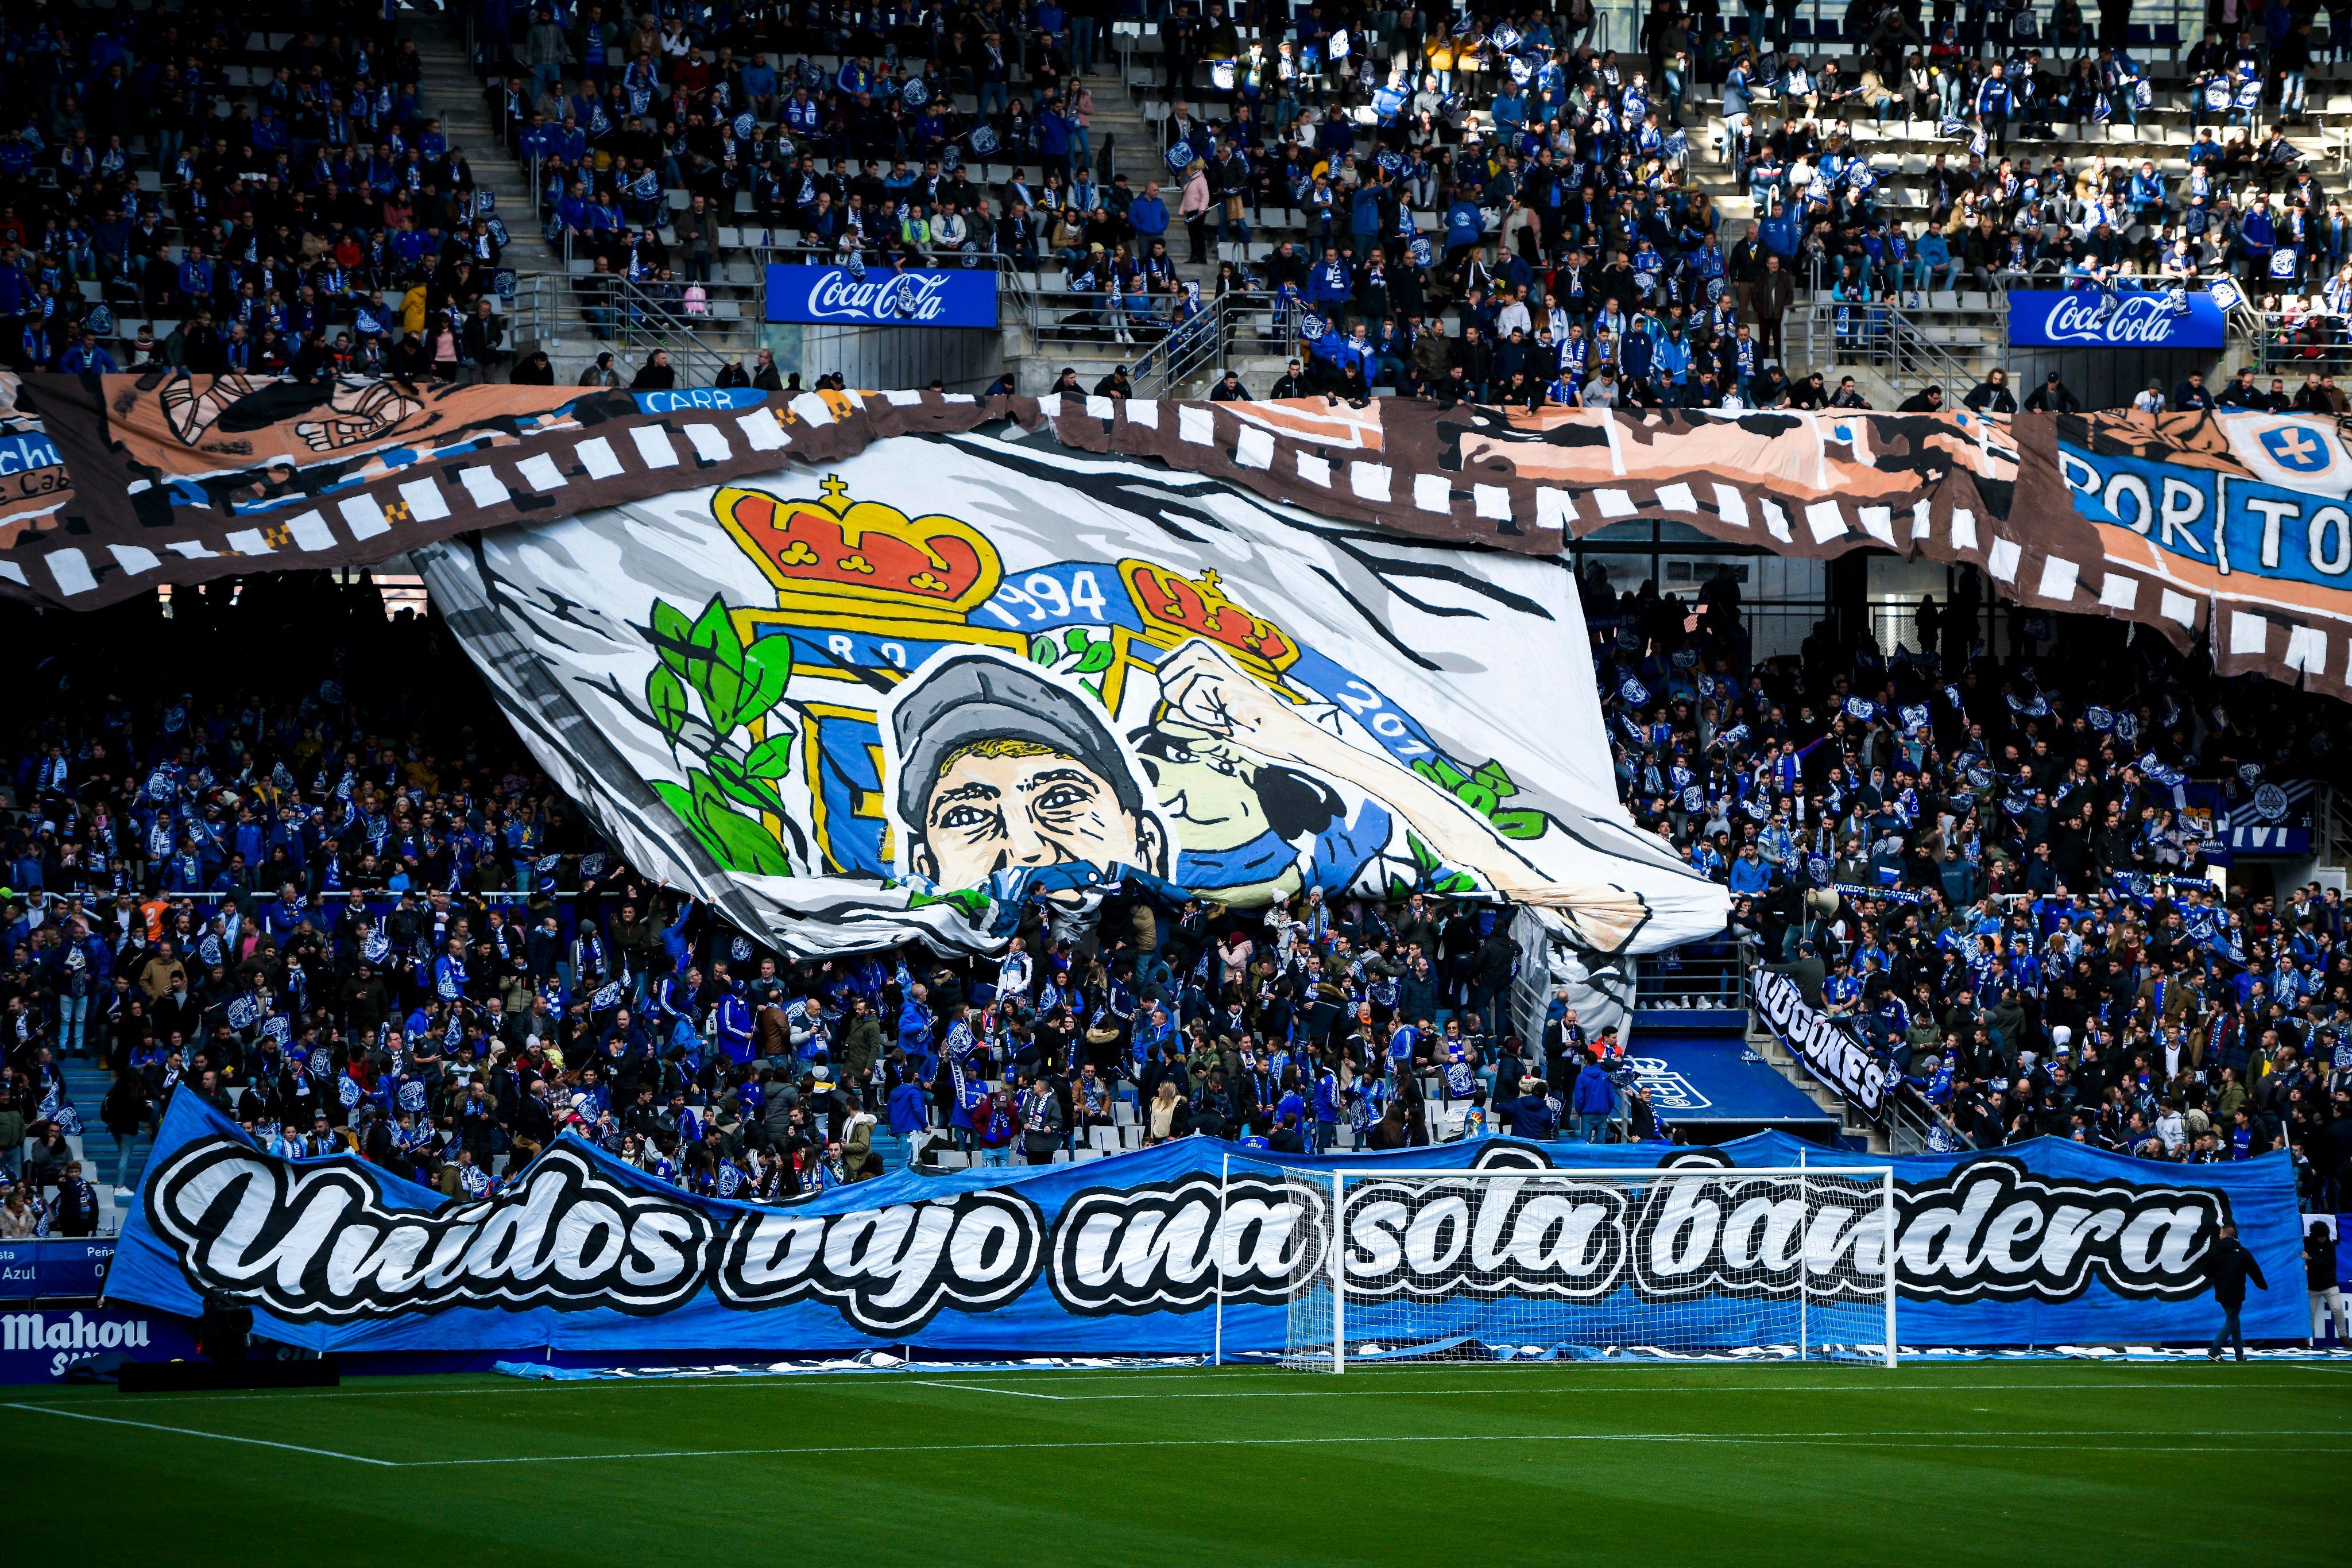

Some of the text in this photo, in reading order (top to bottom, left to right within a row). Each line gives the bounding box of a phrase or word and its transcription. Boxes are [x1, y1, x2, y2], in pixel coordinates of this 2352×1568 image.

[808, 271, 951, 320] Coca-Cla
[2045, 295, 2173, 342] CocaCola
[2059, 450, 2351, 575] POR TO
[983, 571, 1107, 628] 1994
[828, 634, 855, 664] R
[1833, 883, 1920, 903] OVIEDO CAPITAL
[2171, 876, 2207, 886] CAPITAL
[146, 908, 156, 927] 2
[1758, 969, 1885, 1109] LUGONES
[175, 1157, 693, 1296] Unidos
[1075, 1201, 1307, 1288] una
[1344, 1166, 1608, 1277] sola
[1651, 1167, 2211, 1279] bandera
[87, 1247, 115, 1257] Peña
[2, 1267, 36, 1280] Azul
[0, 1311, 151, 1350] Mahou
